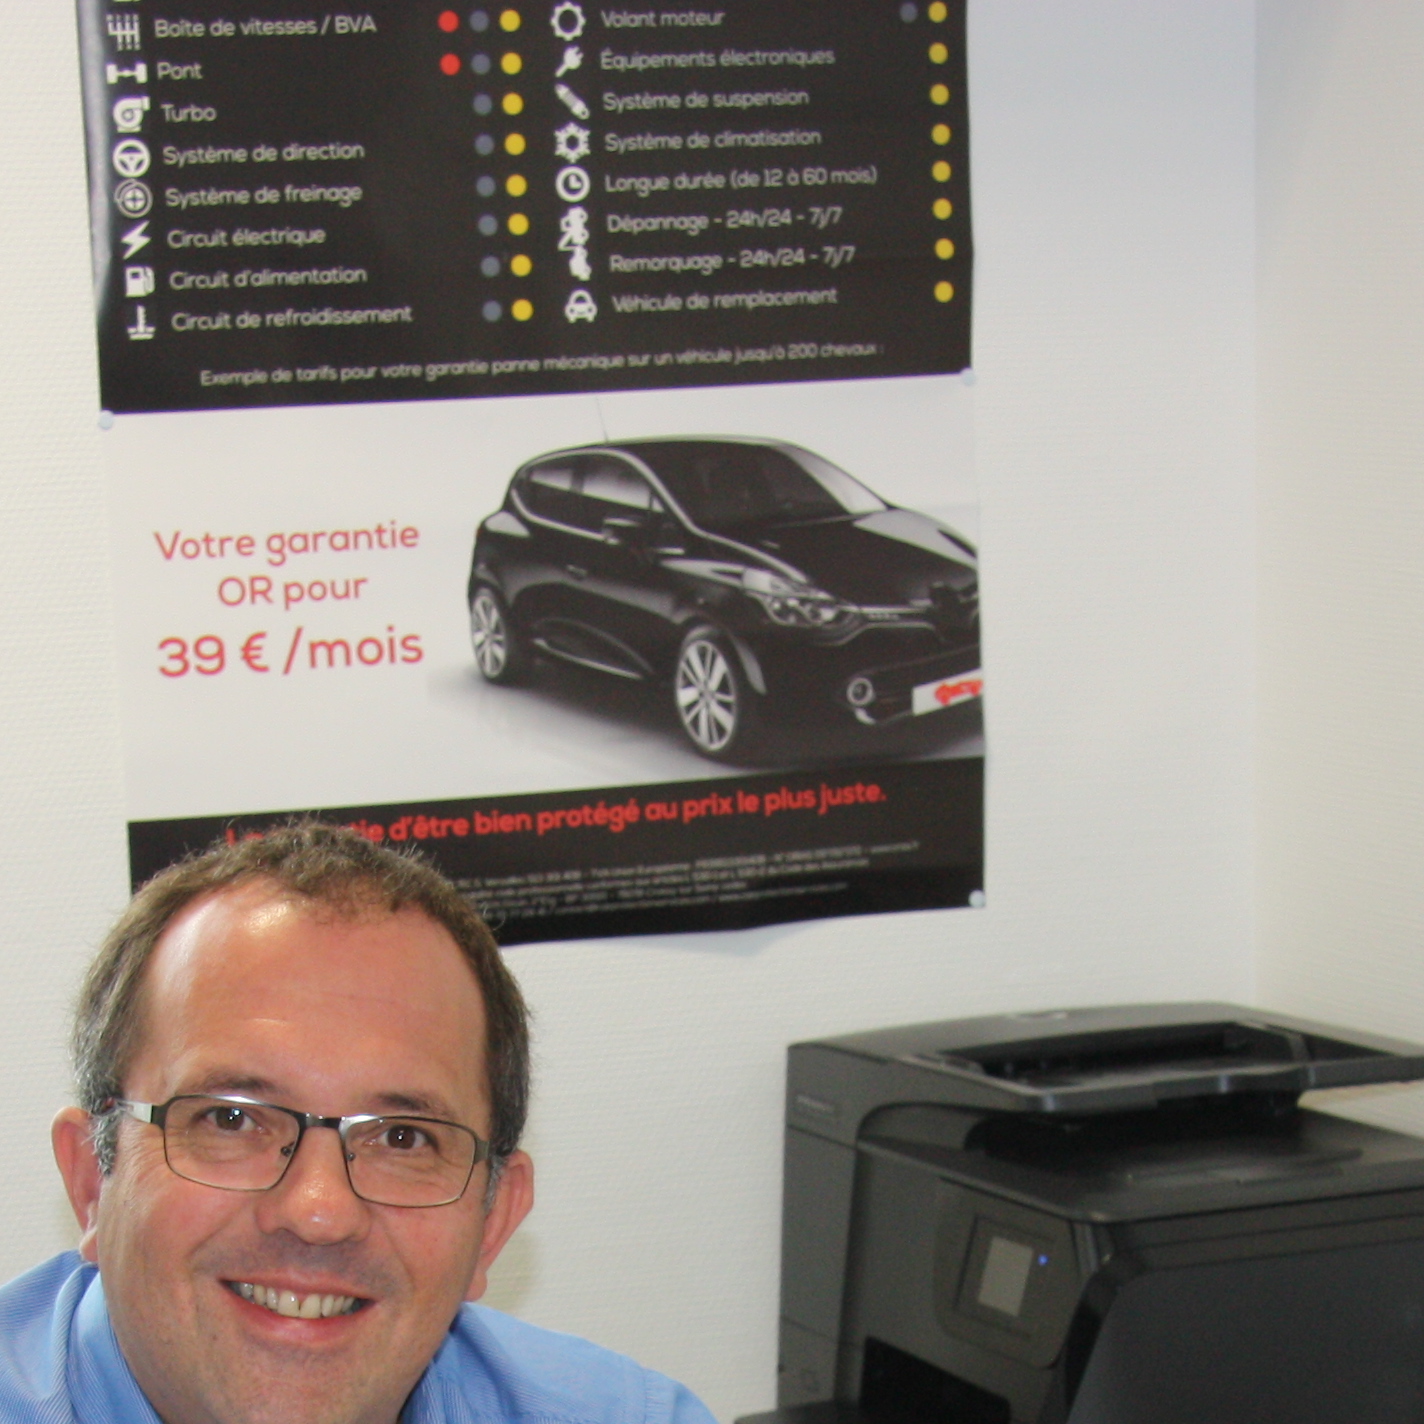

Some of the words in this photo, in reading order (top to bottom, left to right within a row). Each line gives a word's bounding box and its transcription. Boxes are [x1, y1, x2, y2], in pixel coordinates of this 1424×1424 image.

[209, 18, 236, 37] de
[239, 17, 318, 36] vitesses
[320, 14, 332, 36] /
[334, 14, 377, 34] BVA
[600, 10, 660, 29] Volant
[664, 10, 726, 27] moteur
[156, 61, 203, 80] Pont
[718, 48, 836, 68] électroniques
[160, 103, 217, 123] Turbo
[602, 91, 682, 114] Système
[684, 91, 710, 109] de
[712, 91, 810, 110] suspension
[604, 132, 684, 154] Système
[686, 131, 711, 149] de
[713, 129, 822, 149] climatisation
[162, 145, 249, 168] Système
[251, 144, 279, 163] de
[281, 142, 366, 162] direction
[604, 174, 671, 198] Longue
[672, 171, 727, 191] durée
[729, 169, 761, 189] (de
[763, 167, 784, 188] 12
[801, 166, 828, 186] 60
[829, 165, 878, 185] mois)
[164, 187, 251, 210] Système
[254, 186, 281, 204] de
[283, 183, 364, 208] freinage
[606, 213, 710, 237] Dépannage
[725, 208, 793, 229] 24h/24
[808, 205, 843, 230] 7j/7
[166, 229, 229, 249] Circuit
[231, 226, 327, 247] électrique
[609, 254, 724, 276] Remorquage
[739, 247, 806, 268] 24h/24
[822, 245, 856, 269] 7j/7
[168, 270, 230, 291] Circuit
[233, 266, 368, 288] d'alimentation
[611, 293, 683, 313] Véhicule
[685, 293, 711, 310] de
[712, 288, 838, 310] remplacement
[170, 312, 232, 332] Circuit
[235, 311, 262, 329] de
[264, 305, 413, 328] refroidissement
[199, 369, 269, 387] Exemple
[270, 368, 293, 383] de
[295, 364, 338, 382] tarifs
[339, 366, 378, 382] pour
[380, 363, 423, 378] votre
[424, 360, 490, 382] garantie
[490, 359, 541, 376] panne
[543, 355, 626, 371] mécanique
[627, 353, 652, 367] sur
[653, 352, 674, 366] un
[674, 348, 733, 365] véhicule
[786, 342, 819, 360] 200
[819, 343, 877, 358] chevaux
[153, 530, 257, 561] Votre
[265, 521, 421, 568] garantie
[217, 574, 274, 607] OR
[283, 577, 369, 611] pour
[159, 634, 226, 678] 39
[240, 631, 270, 673] €
[387, 814, 471, 842] d'être
[473, 810, 534, 835] bien
[535, 798, 642, 836] protégé
[644, 802, 678, 821] au
[681, 792, 735, 824] prix
[736, 791, 761, 813] le
[763, 786, 819, 816] plus
[815, 782, 887, 815] juste.
